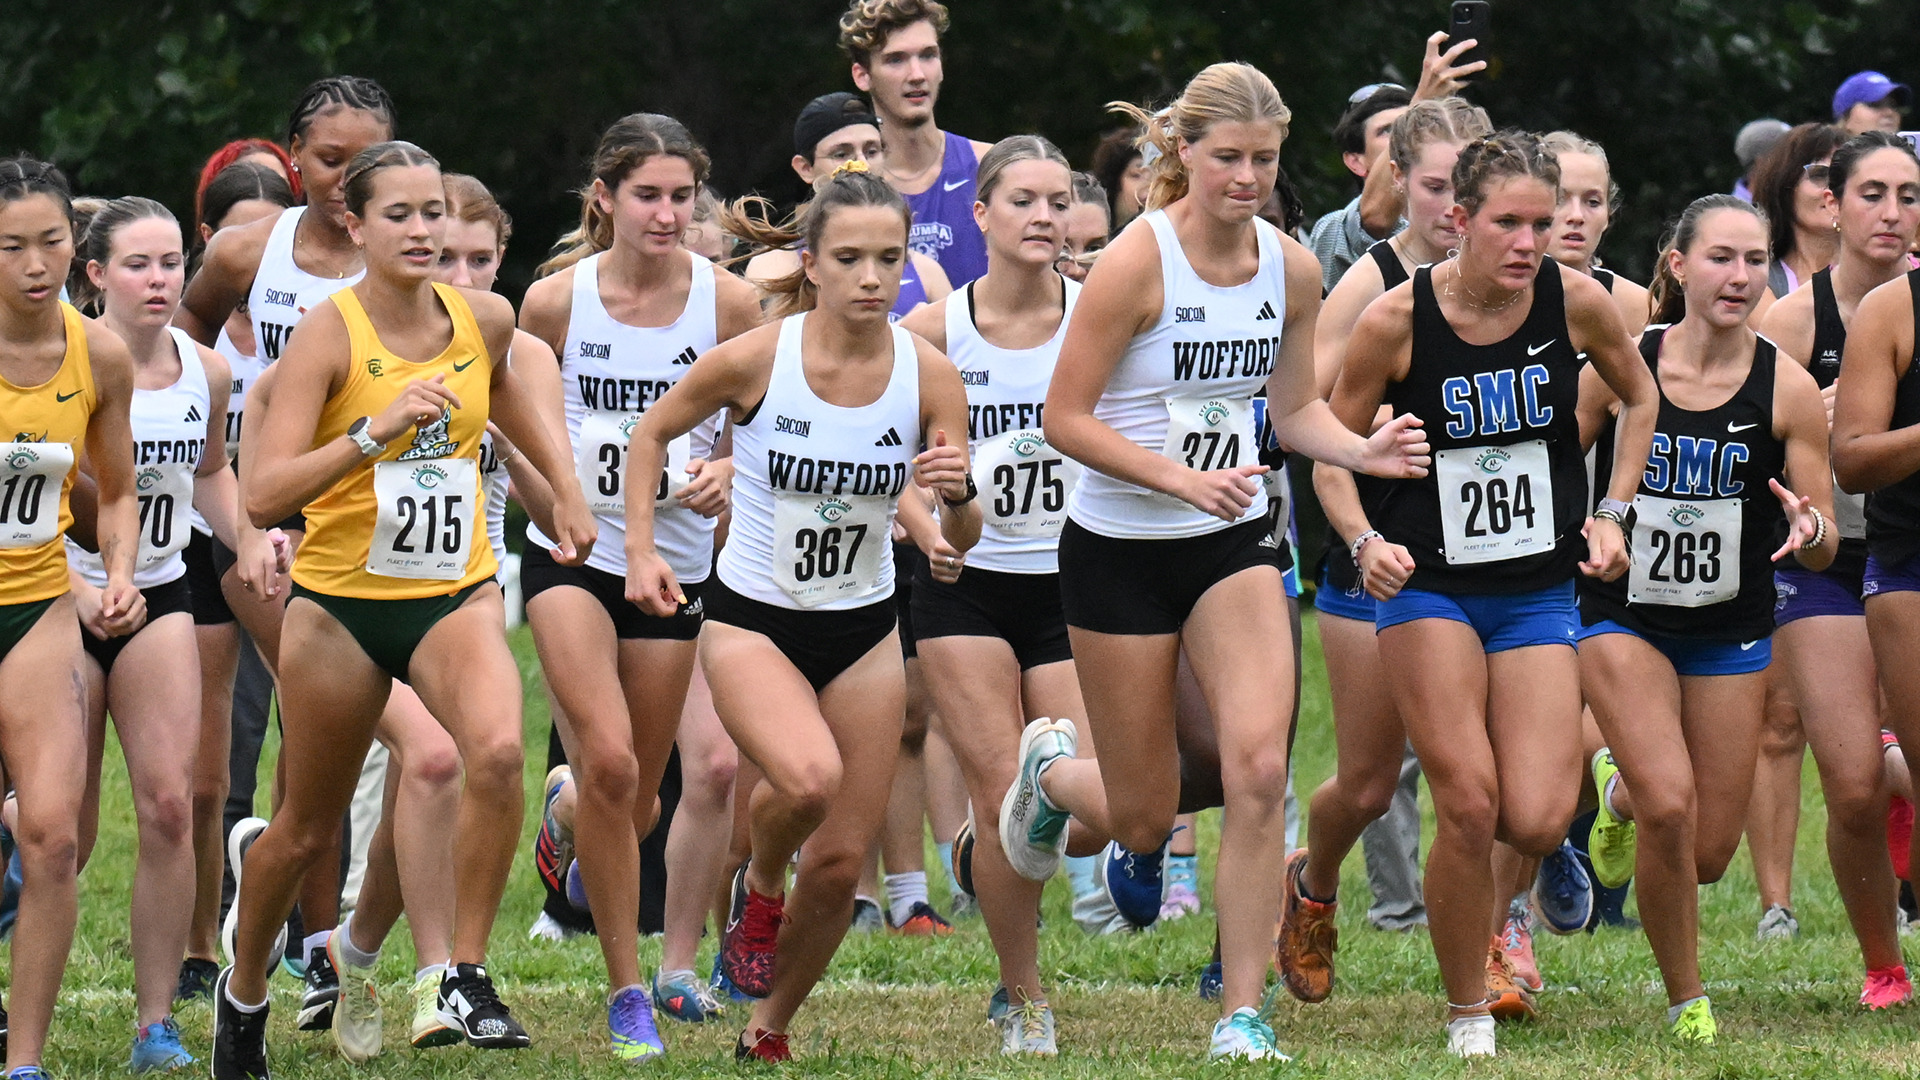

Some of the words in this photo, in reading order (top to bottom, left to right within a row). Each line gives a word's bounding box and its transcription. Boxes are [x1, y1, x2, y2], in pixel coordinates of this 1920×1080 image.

[1175, 306, 1206, 323] SOCON
[580, 341, 611, 360] SOCON
[775, 415, 811, 438] SOCON
[1442, 364, 1553, 439] SMC
[768, 449, 906, 497] WOFFORD
[1182, 432, 1239, 472] 374
[1643, 432, 1750, 497] SMC
[0, 474, 46, 524] 10
[994, 459, 1064, 518] 375
[1460, 474, 1535, 538] 264
[138, 494, 174, 548] 70
[392, 495, 462, 554] 215
[794, 524, 867, 582] 367
[1649, 530, 1721, 584] 263
